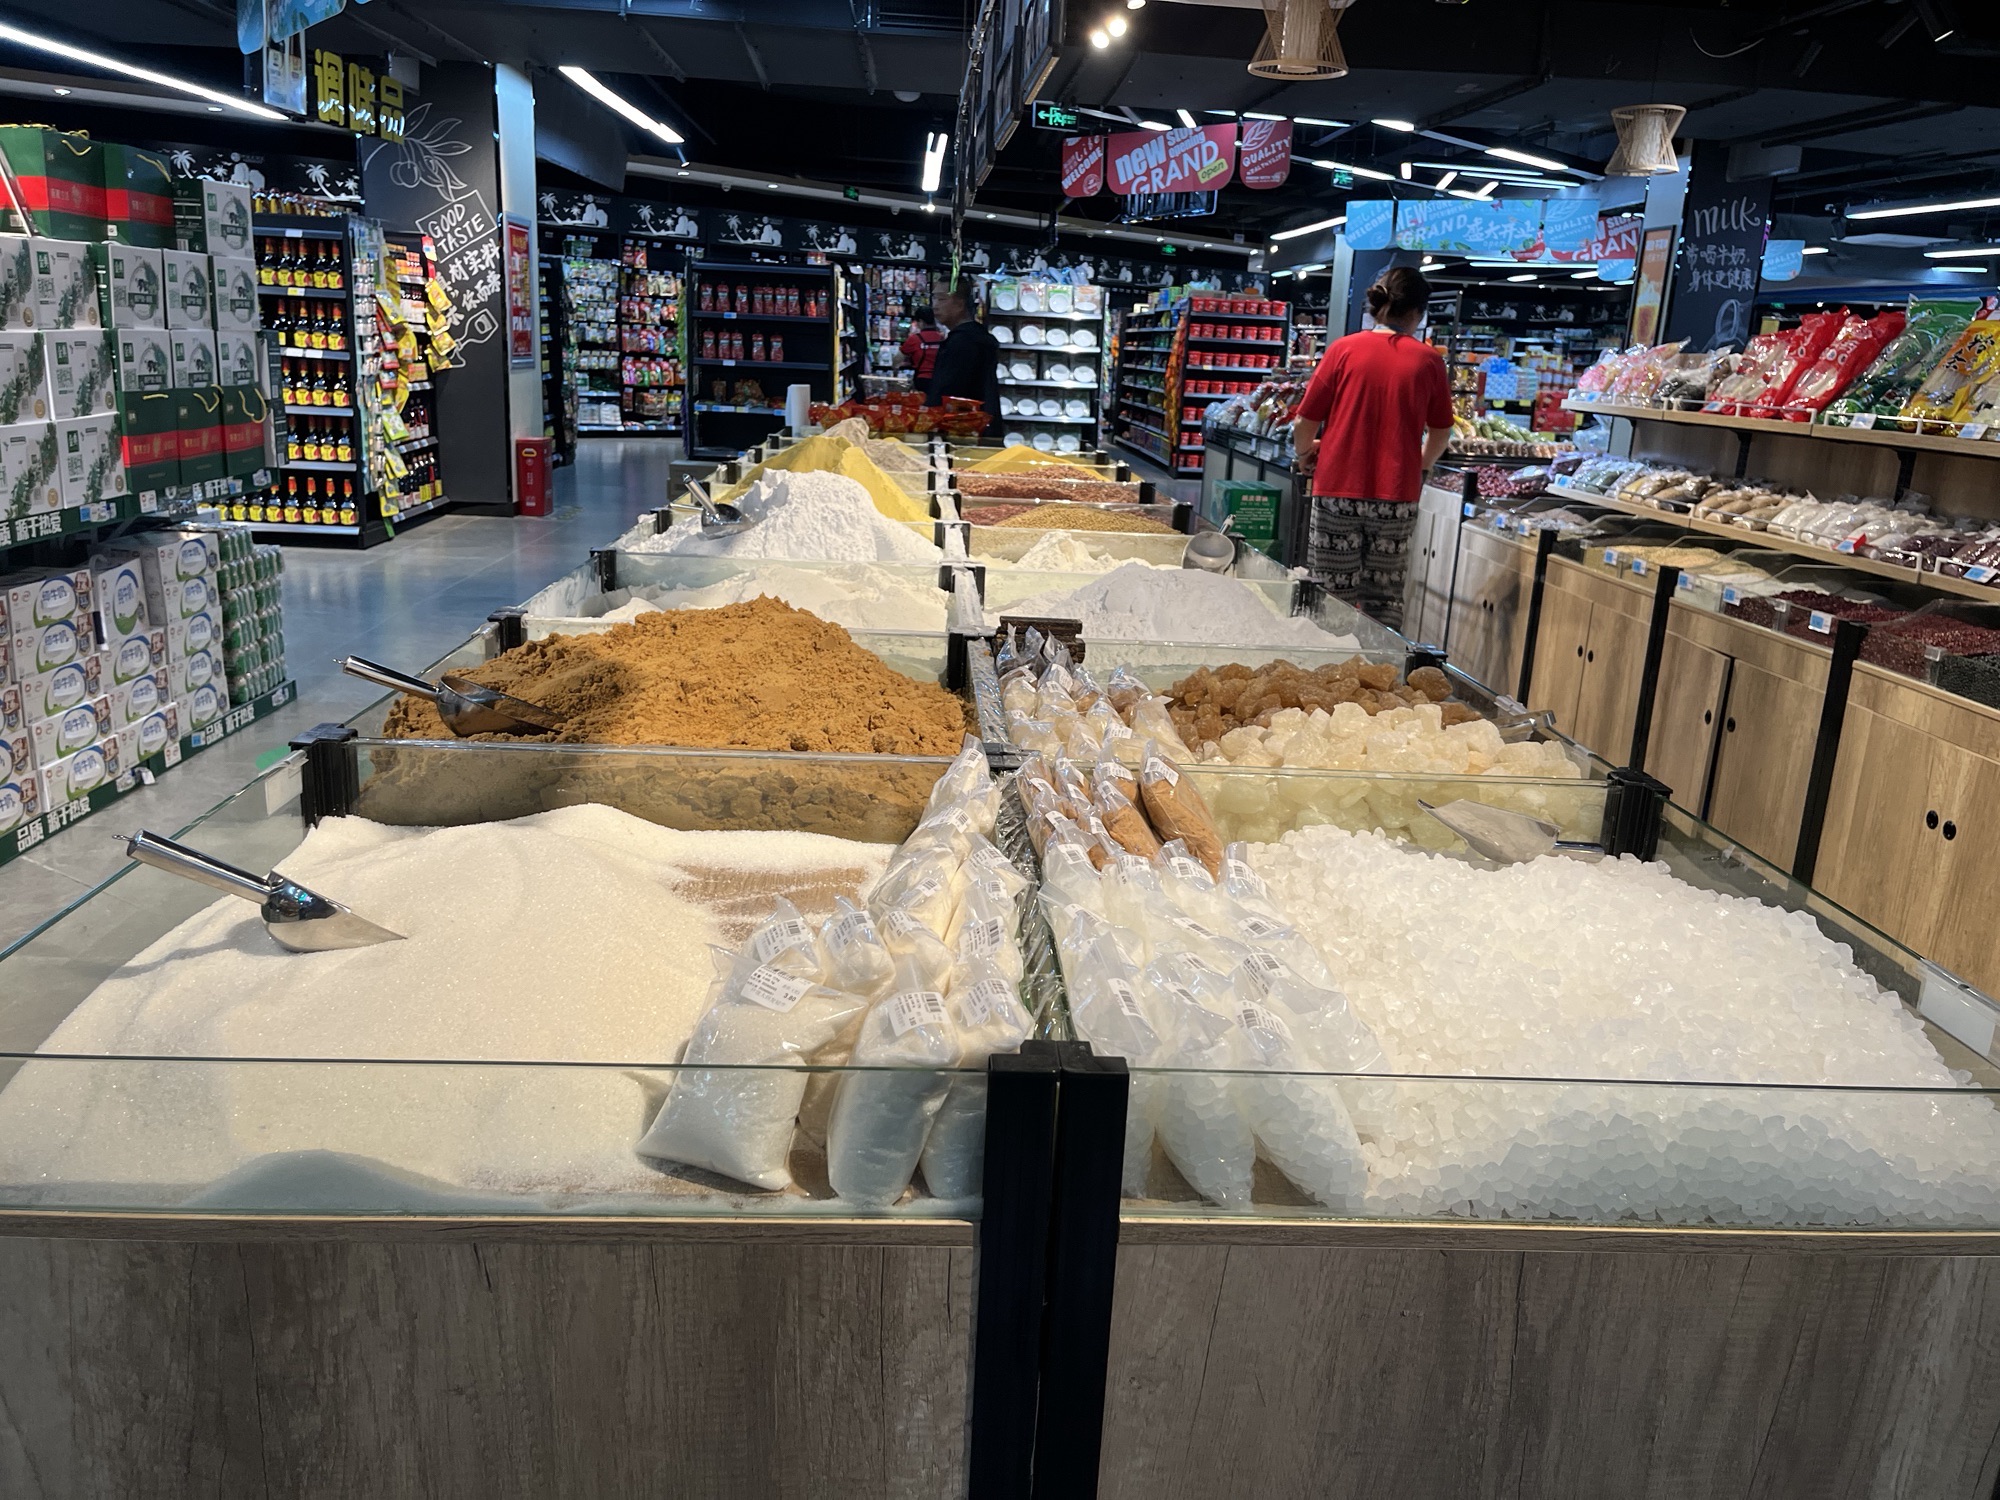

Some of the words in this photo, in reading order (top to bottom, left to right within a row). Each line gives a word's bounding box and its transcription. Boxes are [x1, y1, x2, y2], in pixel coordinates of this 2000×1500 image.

[315, 48, 406, 146] 调味品
[1114, 134, 1167, 185] new
[1130, 139, 1220, 195] GRAND
[1200, 161, 1225, 181] open
[1242, 135, 1291, 168] QUALITY
[428, 203, 466, 239] GOOD
[437, 213, 485, 255] TASTE
[1401, 213, 1469, 247] GRAND
[1694, 196, 1762, 238] milk
[15, 511, 62, 542] 源于热爱
[17, 817, 44, 853] 品质
[47, 796, 91, 834] 源于热爱
